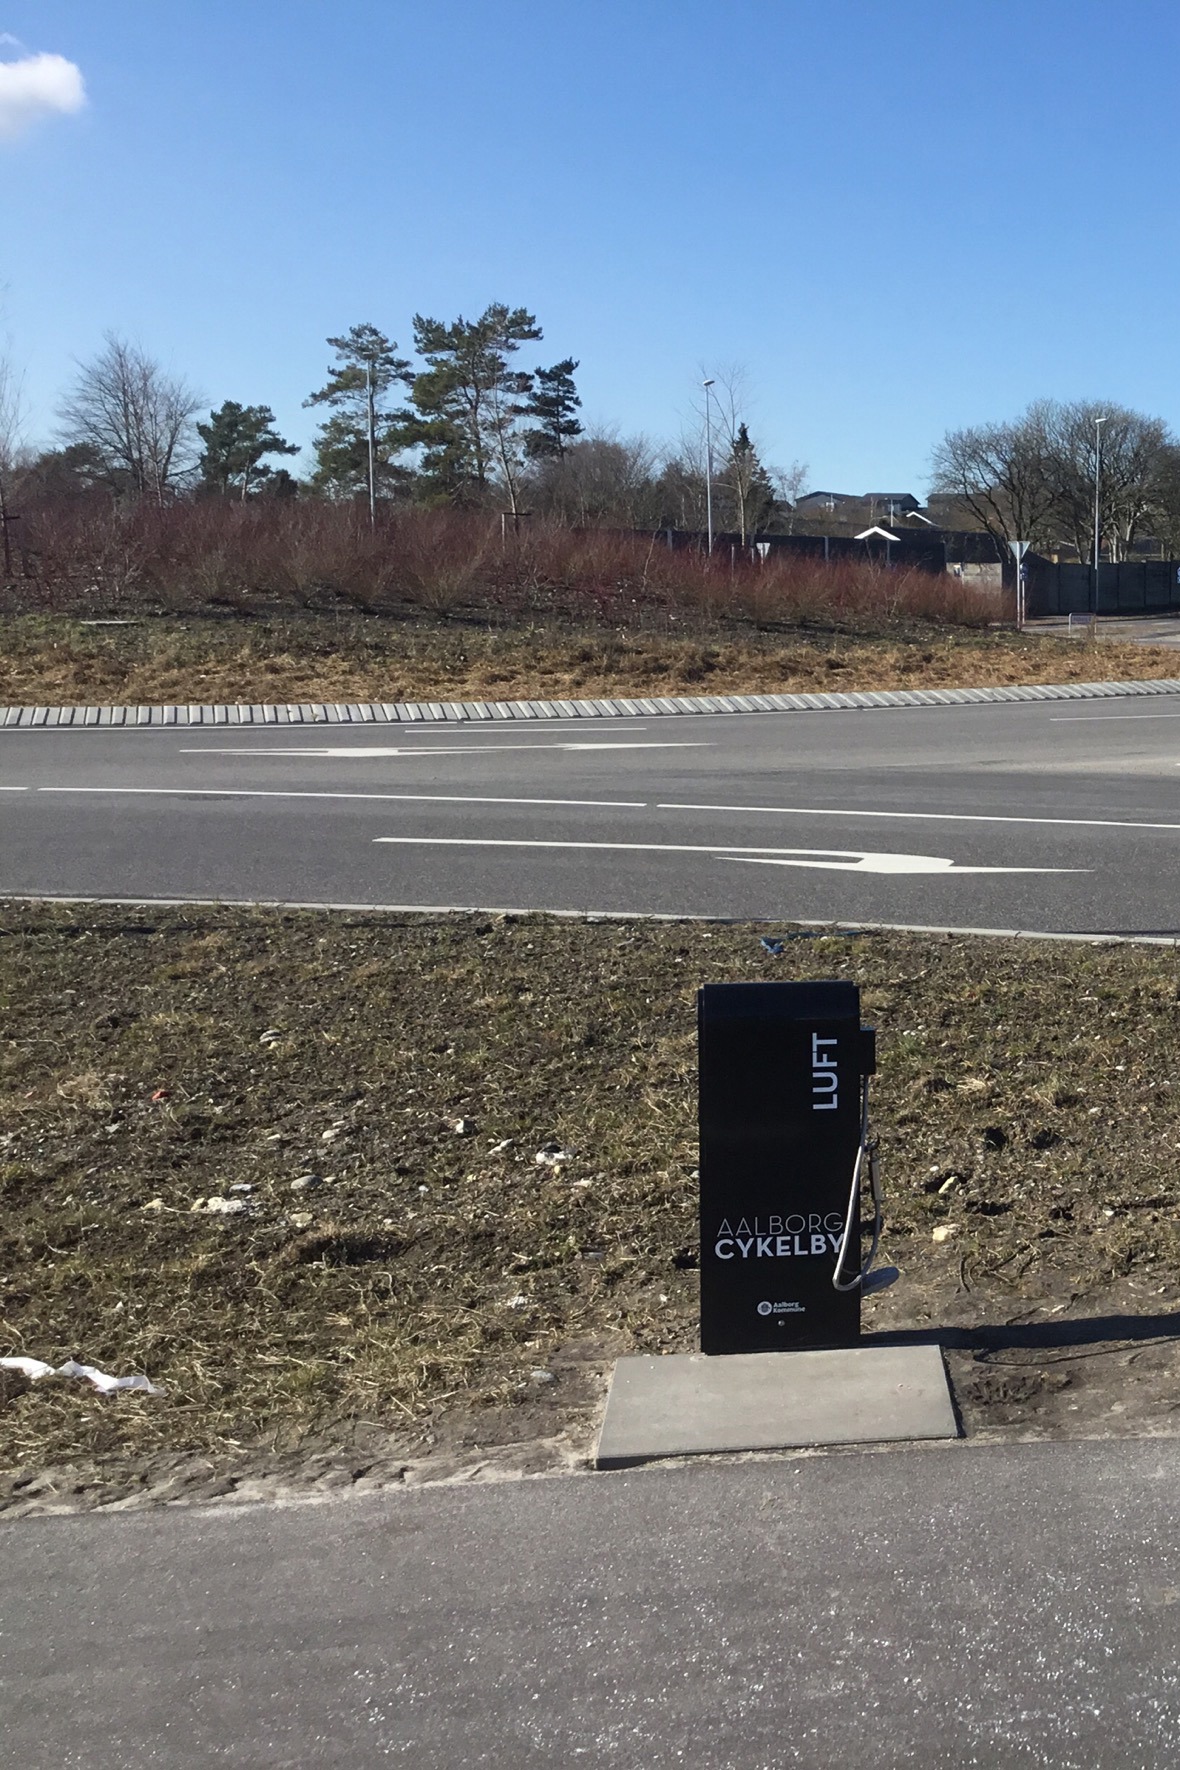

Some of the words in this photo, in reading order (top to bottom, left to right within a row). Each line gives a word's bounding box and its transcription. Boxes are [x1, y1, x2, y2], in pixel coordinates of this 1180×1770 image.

[812, 1032, 838, 1110] LUFT
[717, 1212, 844, 1238] AALBORG
[714, 1233, 845, 1260] CYKELBY
